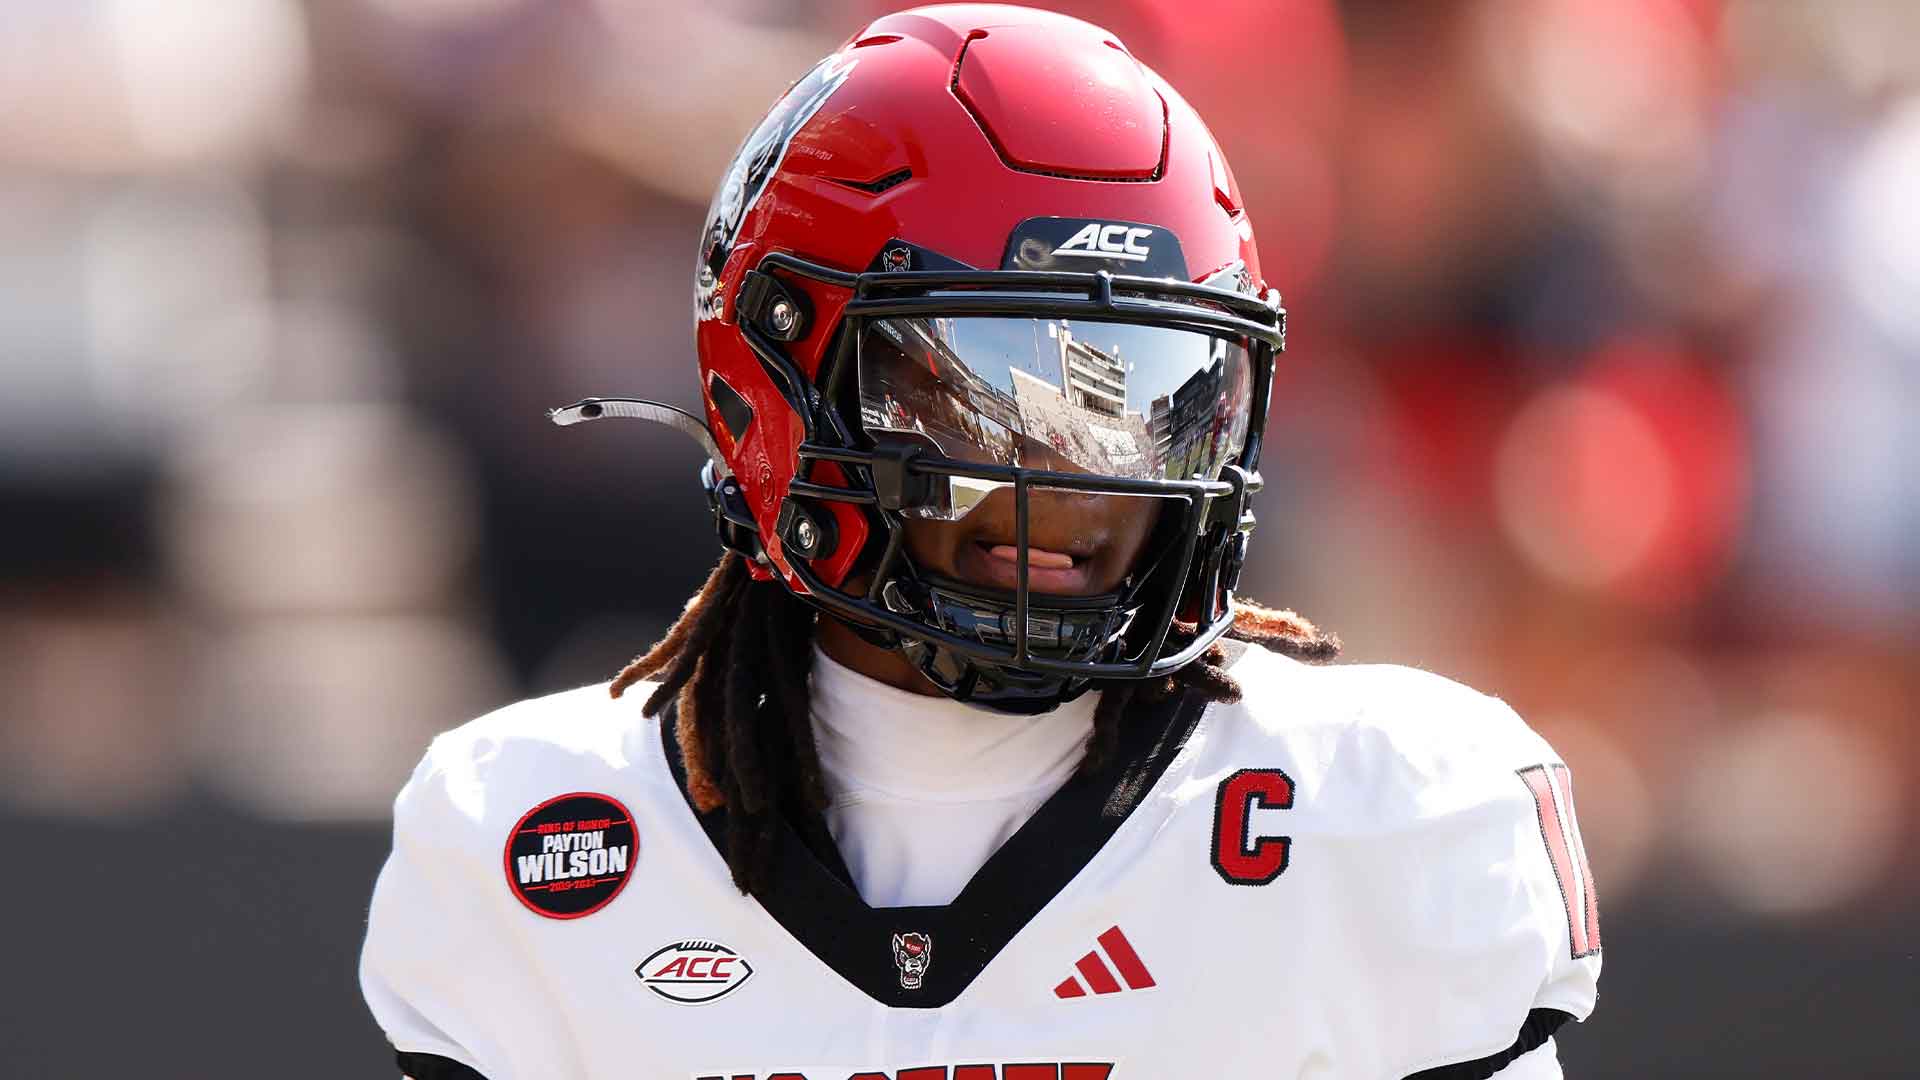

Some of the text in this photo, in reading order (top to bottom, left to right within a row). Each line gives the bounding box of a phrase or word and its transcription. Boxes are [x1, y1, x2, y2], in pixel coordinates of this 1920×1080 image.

[1058, 224, 1153, 256] ACC
[563, 822, 575, 832] OF
[1210, 768, 1296, 886] C
[543, 830, 604, 853] PAYTON
[517, 845, 628, 883] WILSON
[653, 957, 737, 978] ACC
